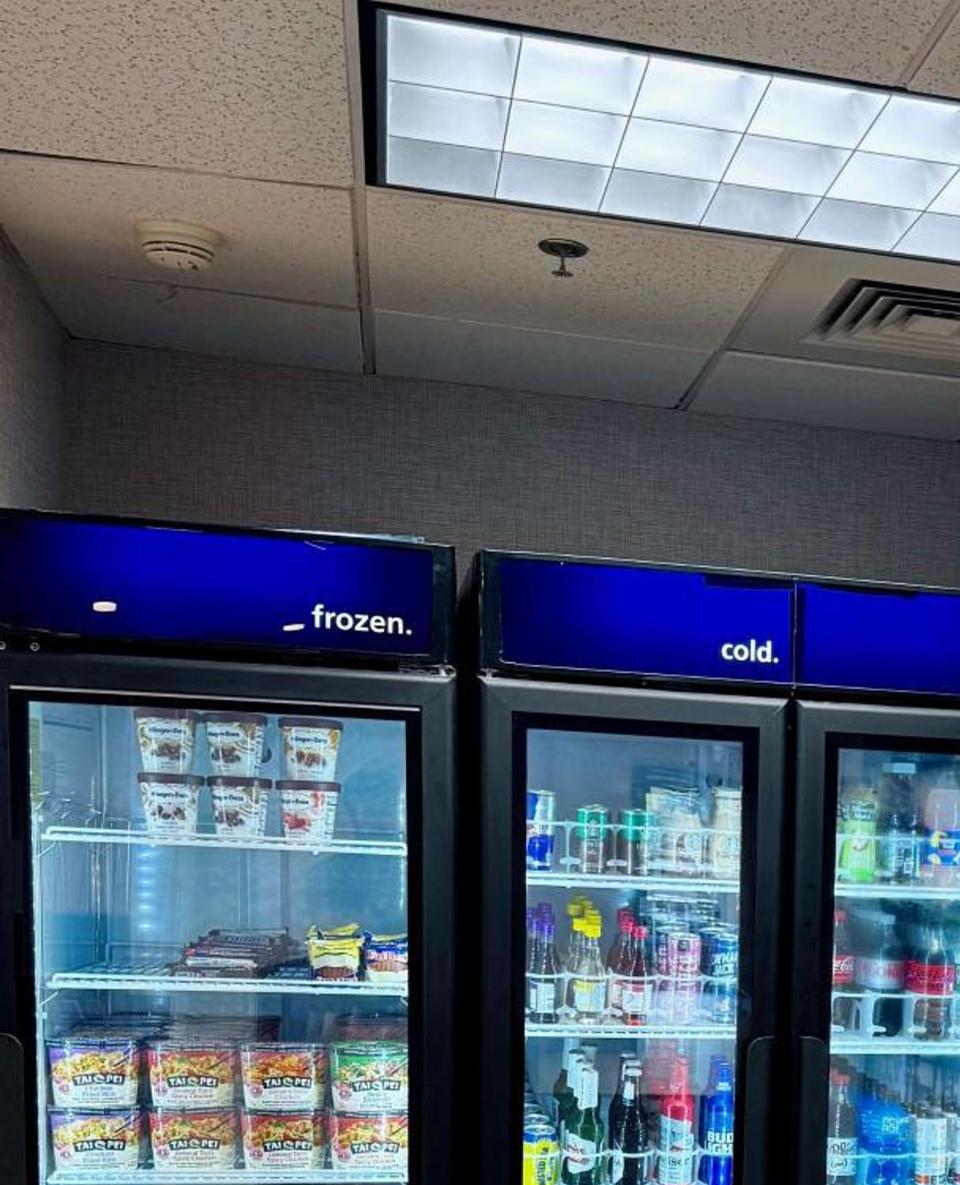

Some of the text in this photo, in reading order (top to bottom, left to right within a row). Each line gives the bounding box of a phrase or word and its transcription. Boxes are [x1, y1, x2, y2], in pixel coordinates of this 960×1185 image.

[311, 604, 413, 636] frozen.
[721, 640, 779, 664] cold.
[74, 1074, 123, 1086] TAI PEI
[168, 1077, 218, 1087] TAI PEI
[264, 1077, 312, 1088] TAI PEI
[353, 1081, 399, 1091] TAI PEI
[75, 1140, 124, 1151] TAI PEI
[170, 1139, 219, 1150] TAI PEI
[264, 1140, 312, 1151] TAI PEI
[352, 1143, 399, 1154] TAI PEI
